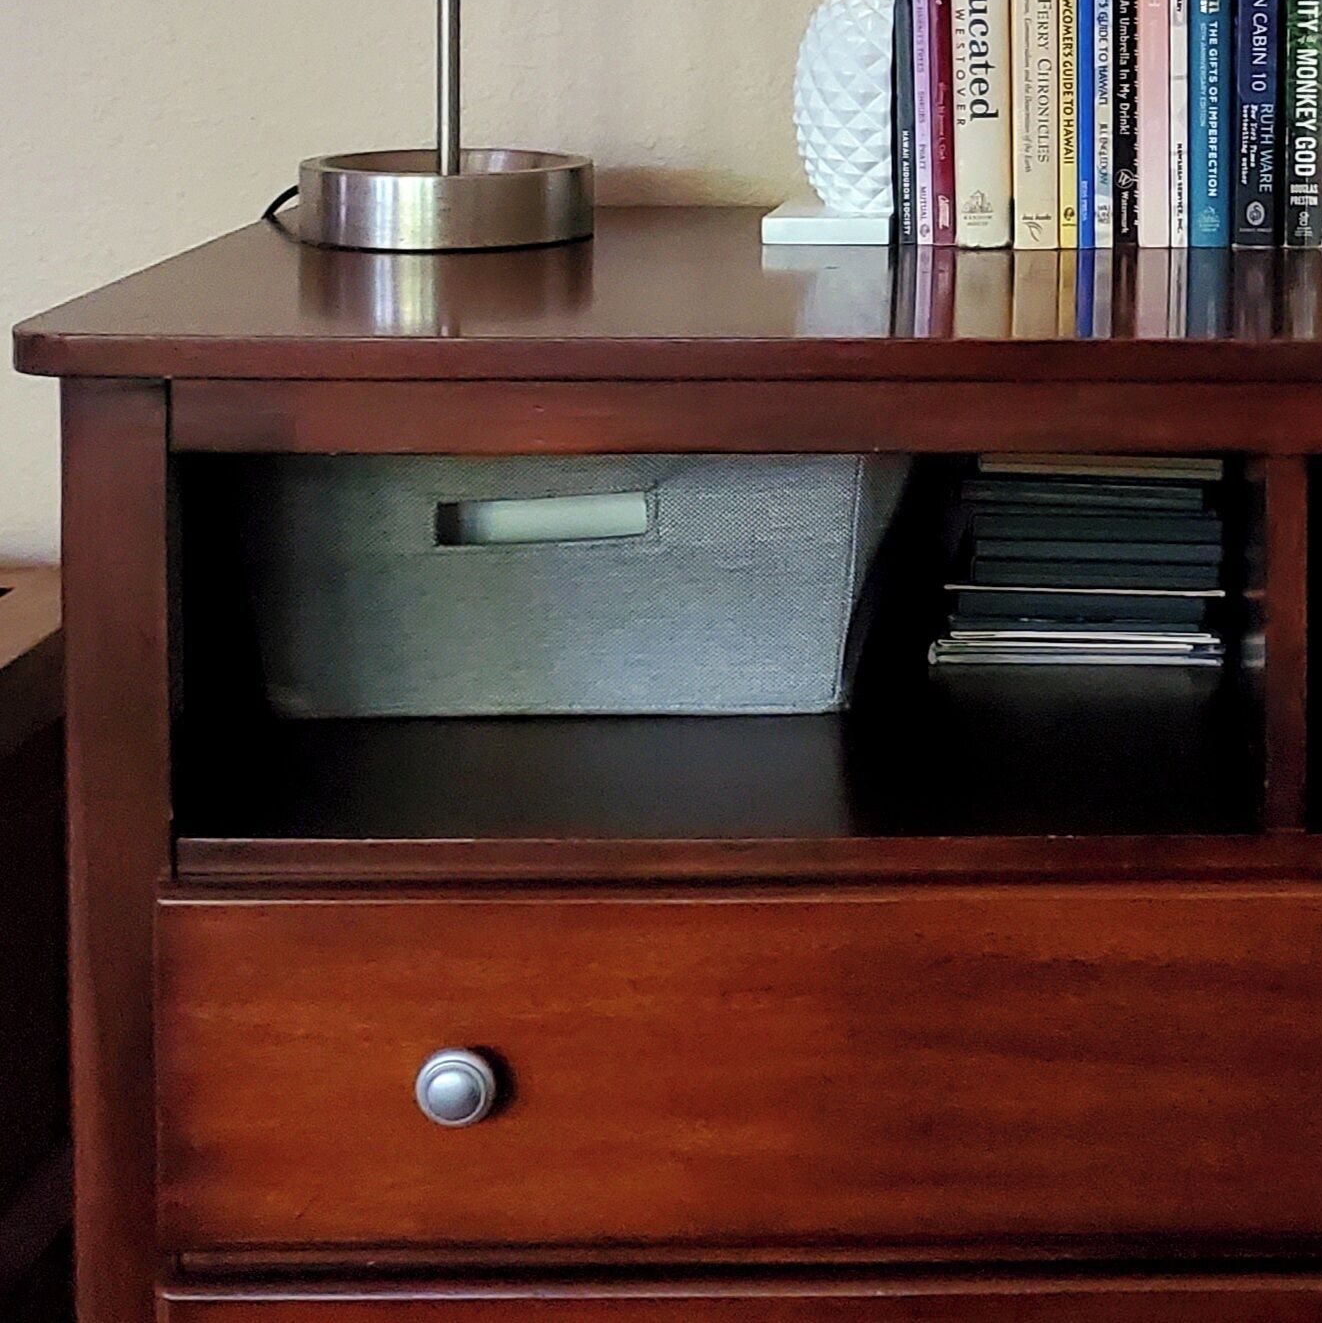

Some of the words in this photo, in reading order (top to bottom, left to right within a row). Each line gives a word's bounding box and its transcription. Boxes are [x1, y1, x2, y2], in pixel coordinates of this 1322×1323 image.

[1119, 0, 1130, 14] An
[1098, 11, 1109, 43] GUIDE
[1119, 18, 1130, 65] Umbrella
[1208, 21, 1218, 45] THE
[1252, 12, 1268, 64] CABIN
[955, 9, 966, 126] WESTOVER
[1099, 47, 1109, 62] TO
[1208, 48, 1218, 83] GIFTS
[1063, 60, 1074, 96] GUIDE
[1117, 83, 1130, 99] My
[1119, 69, 1130, 80] In
[1251, 72, 1267, 92] 10
[1295, 48, 1318, 132] MONKEY
[1037, 59, 1052, 163] CHRONICLES
[1063, 99, 1074, 115] TO
[1207, 86, 1218, 103] OF
[1119, 102, 1130, 135] Drink!
[1250, 122, 1259, 142] York
[1259, 104, 1273, 143] RUTH
[902, 130, 910, 158] HAWAII
[1063, 118, 1074, 164] HAWAII
[1207, 106, 1218, 197] IMPERFECTION
[1250, 144, 1258, 167] Times
[1294, 136, 1317, 177] GOD
[1241, 157, 1249, 185] author
[1258, 149, 1273, 193] WARE
[919, 186, 927, 219] MUTUAL
[1290, 183, 1318, 194] DOUGLAS
[1290, 195, 1318, 206] PRESTON
[903, 202, 911, 235] SOCIETY
[1121, 191, 1130, 233] Watermark
